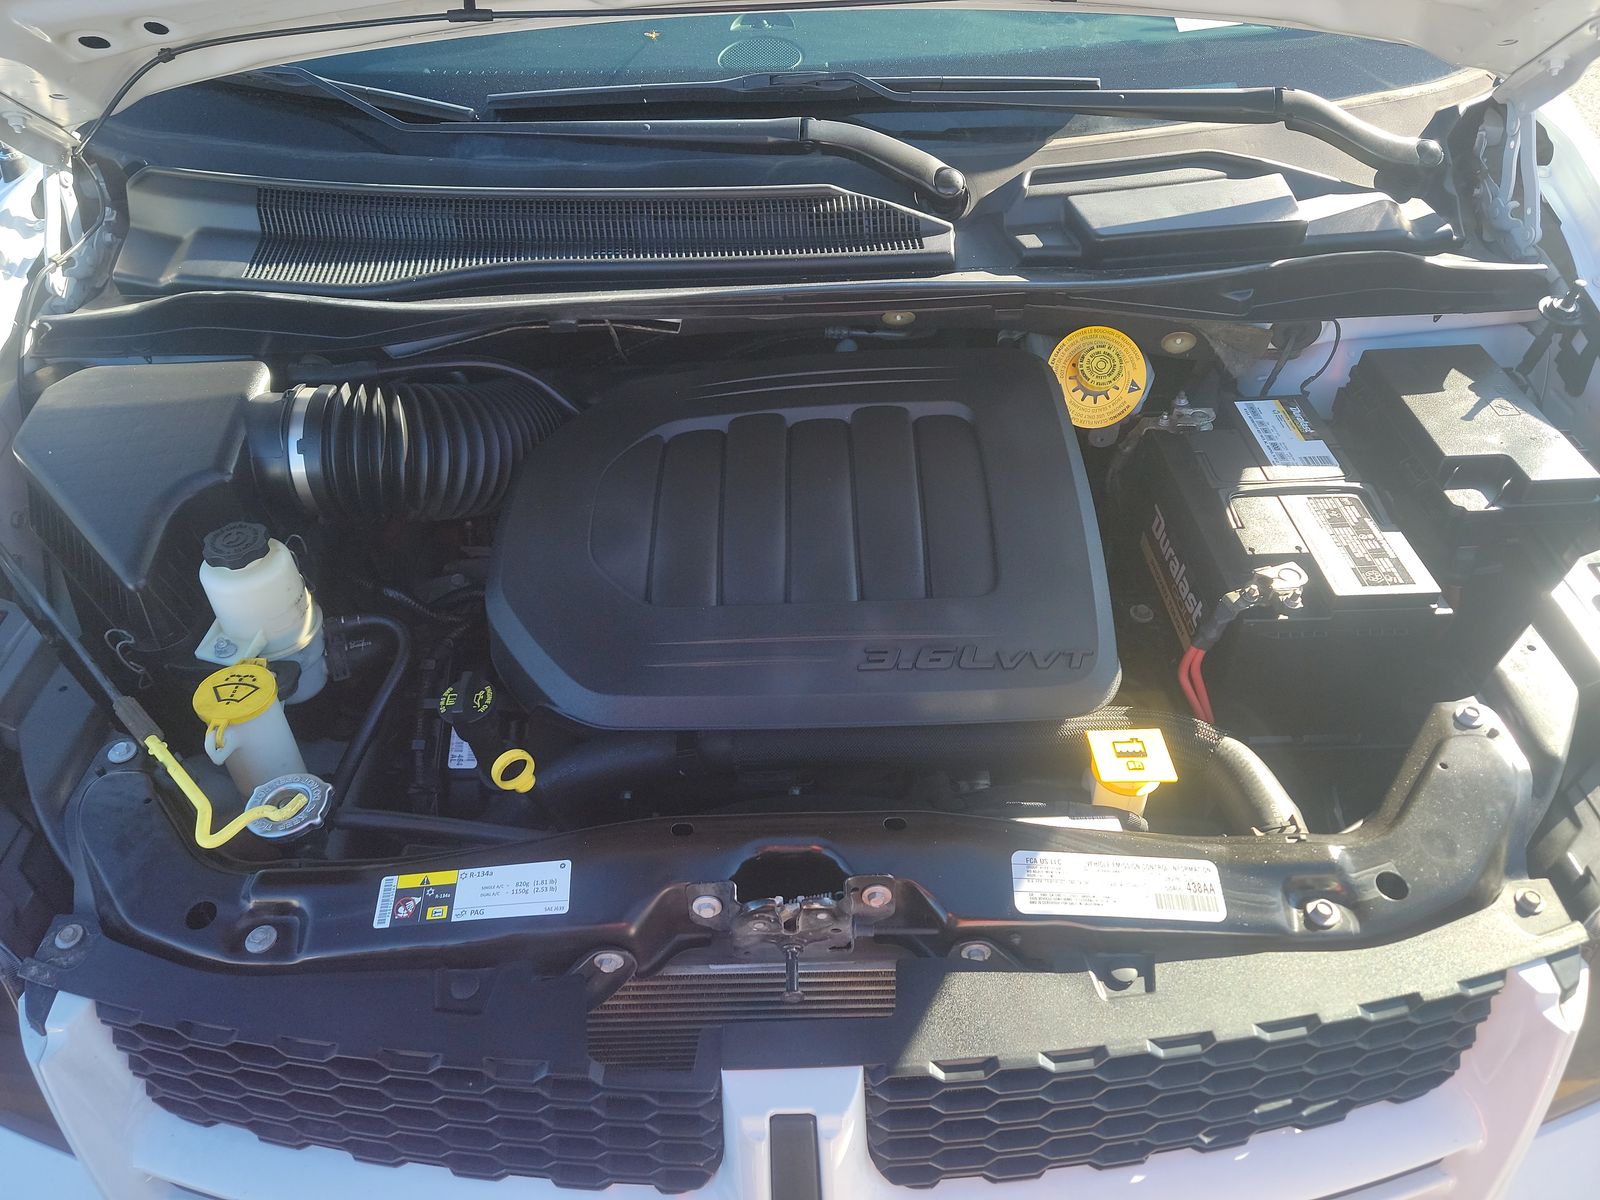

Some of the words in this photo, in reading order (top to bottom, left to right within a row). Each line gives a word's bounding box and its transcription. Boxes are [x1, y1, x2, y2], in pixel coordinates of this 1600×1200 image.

[1054, 342, 1066, 358] GARDE
[1066, 330, 1087, 342] NETTOYER
[1120, 336, 1141, 361] REMPLISSAGE
[1099, 335, 1125, 350] UNIQUEMENT
[1063, 344, 1083, 366] PROVENANT
[1108, 404, 1131, 421] WARNING:
[1152, 504, 1203, 628] Duralast
[484, 686, 492, 704] ENGINE
[478, 704, 488, 712] OIL
[469, 870, 493, 878] R-134a
[1186, 882, 1216, 894] 438AA
